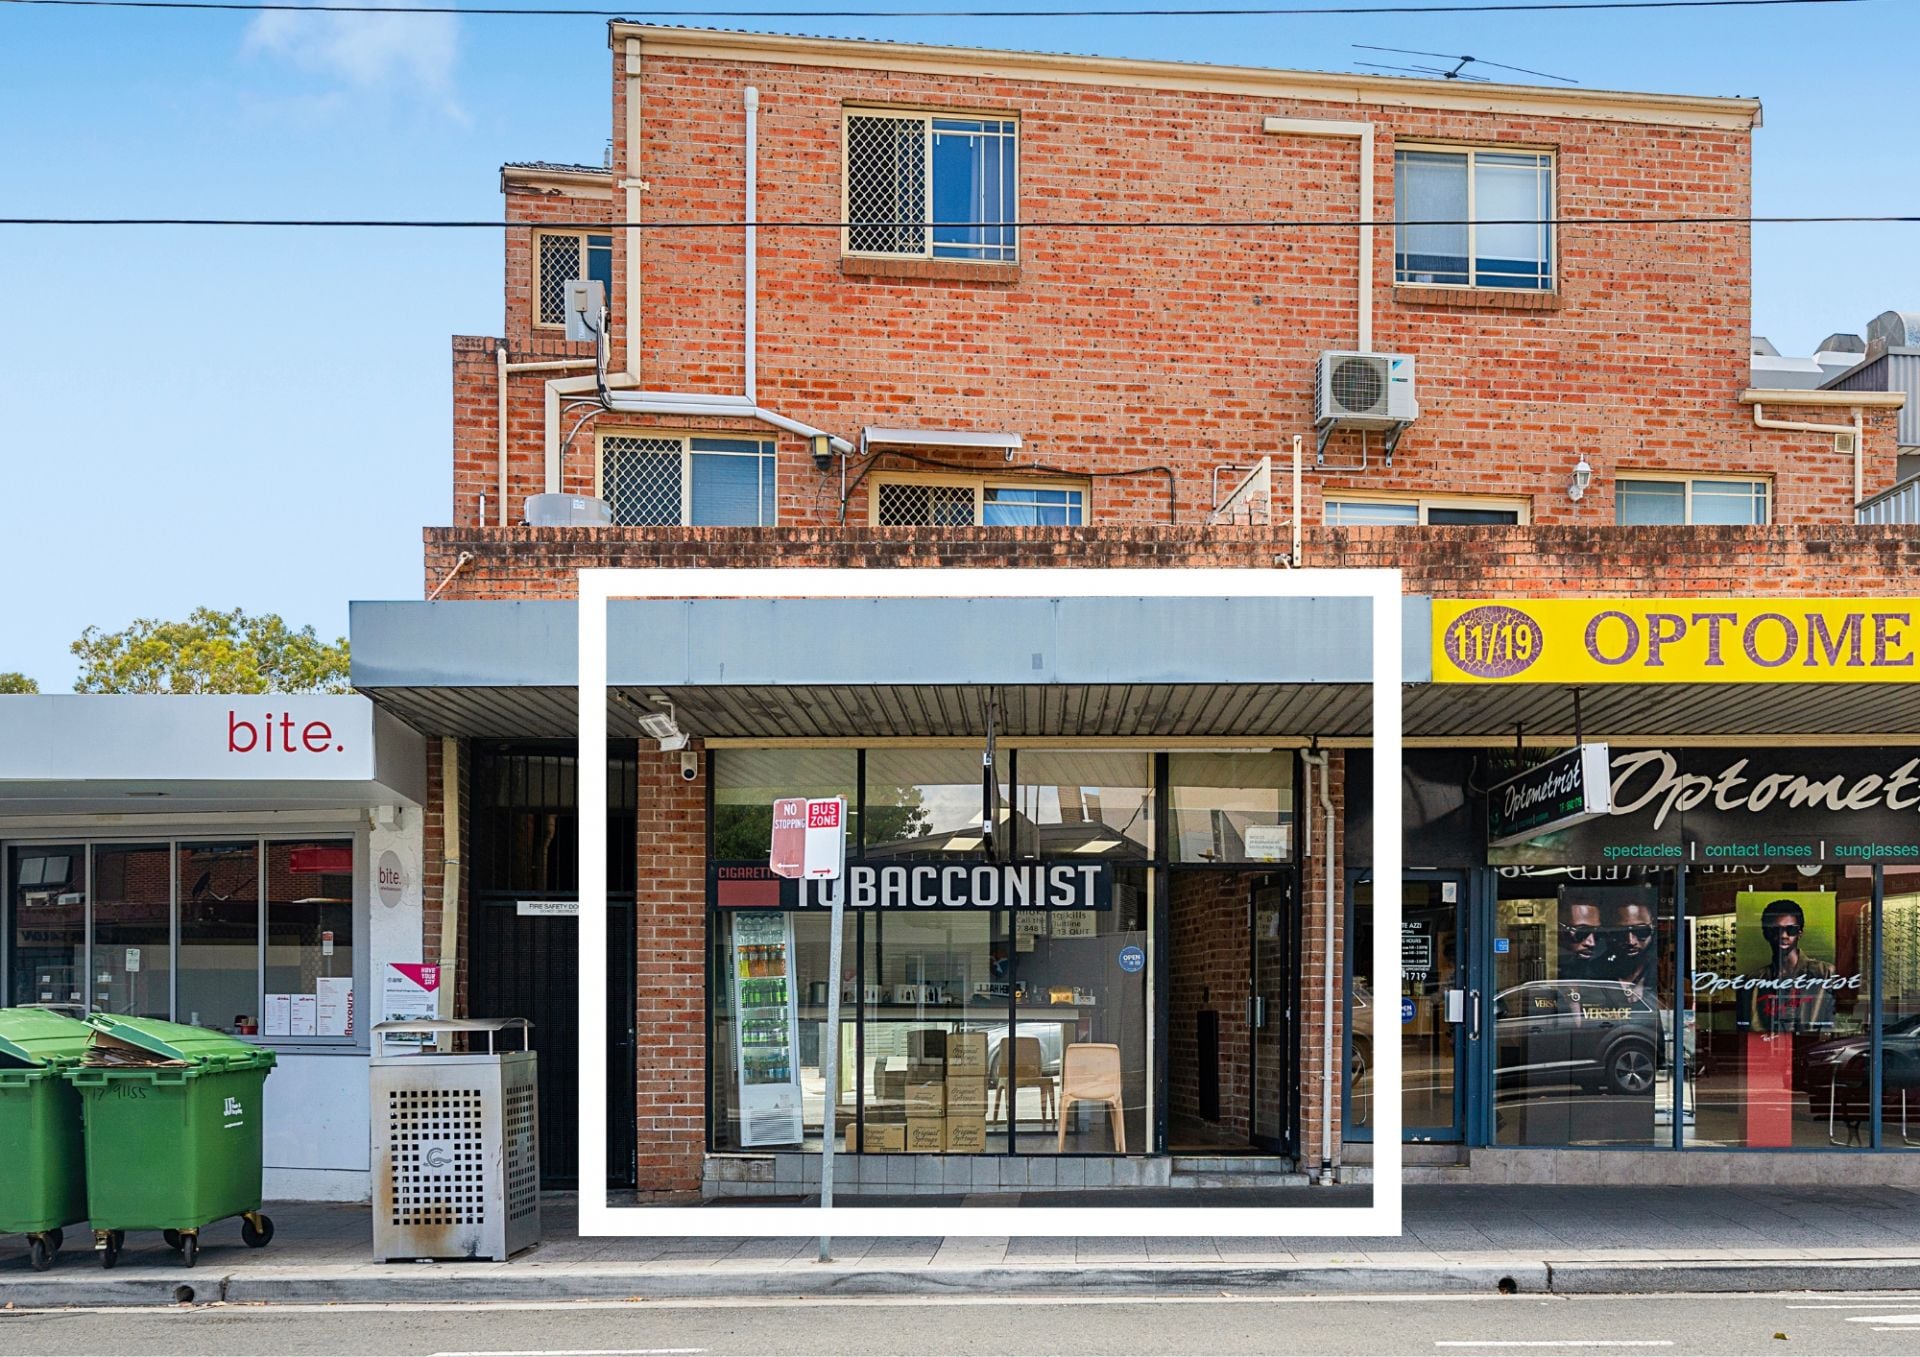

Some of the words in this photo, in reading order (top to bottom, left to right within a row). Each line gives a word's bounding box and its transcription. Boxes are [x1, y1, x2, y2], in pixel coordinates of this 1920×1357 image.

[1455, 623, 1532, 664] 11/19
[1584, 610, 1915, 668] OPTOME
[228, 710, 344, 753] bite.
[1504, 759, 1581, 822] Optometrist
[783, 803, 797, 816] NO
[812, 804, 836, 815] BUS
[774, 818, 806, 830] STOPPING
[810, 815, 837, 827] ZONE
[1603, 843, 1683, 858] spectacles
[1705, 844, 1760, 857] contact
[1763, 843, 1812, 857] lenses
[1835, 843, 1919, 859] sunglasses
[1691, 971, 1863, 994] Optometrist
[1583, 1007, 1632, 1020] VERSACE
